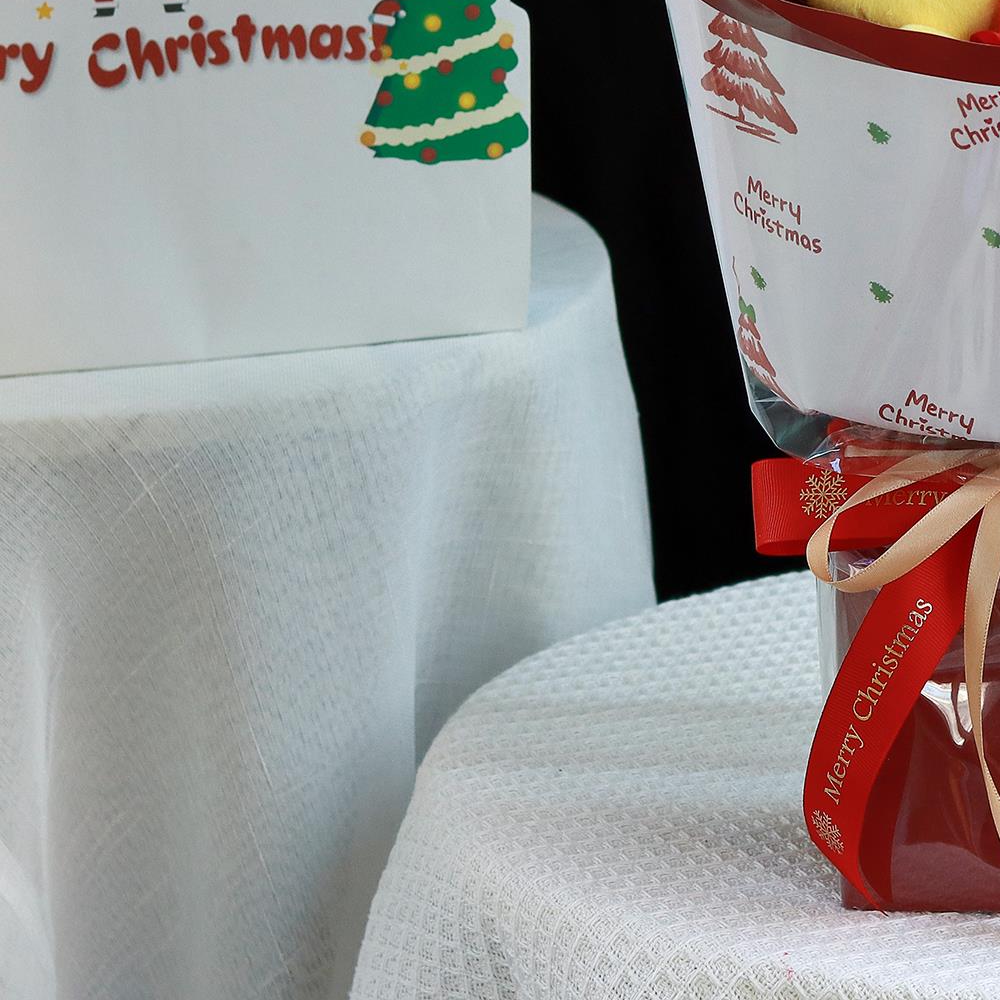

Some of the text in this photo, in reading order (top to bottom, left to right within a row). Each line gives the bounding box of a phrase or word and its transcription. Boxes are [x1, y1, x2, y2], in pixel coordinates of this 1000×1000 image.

[88, 13, 389, 88] Christmas!
[733, 191, 823, 254] Christmas
[747, 175, 802, 225] Merry
[905, 389, 975, 435] Merry
[824, 597, 934, 805] Merry Christmas
